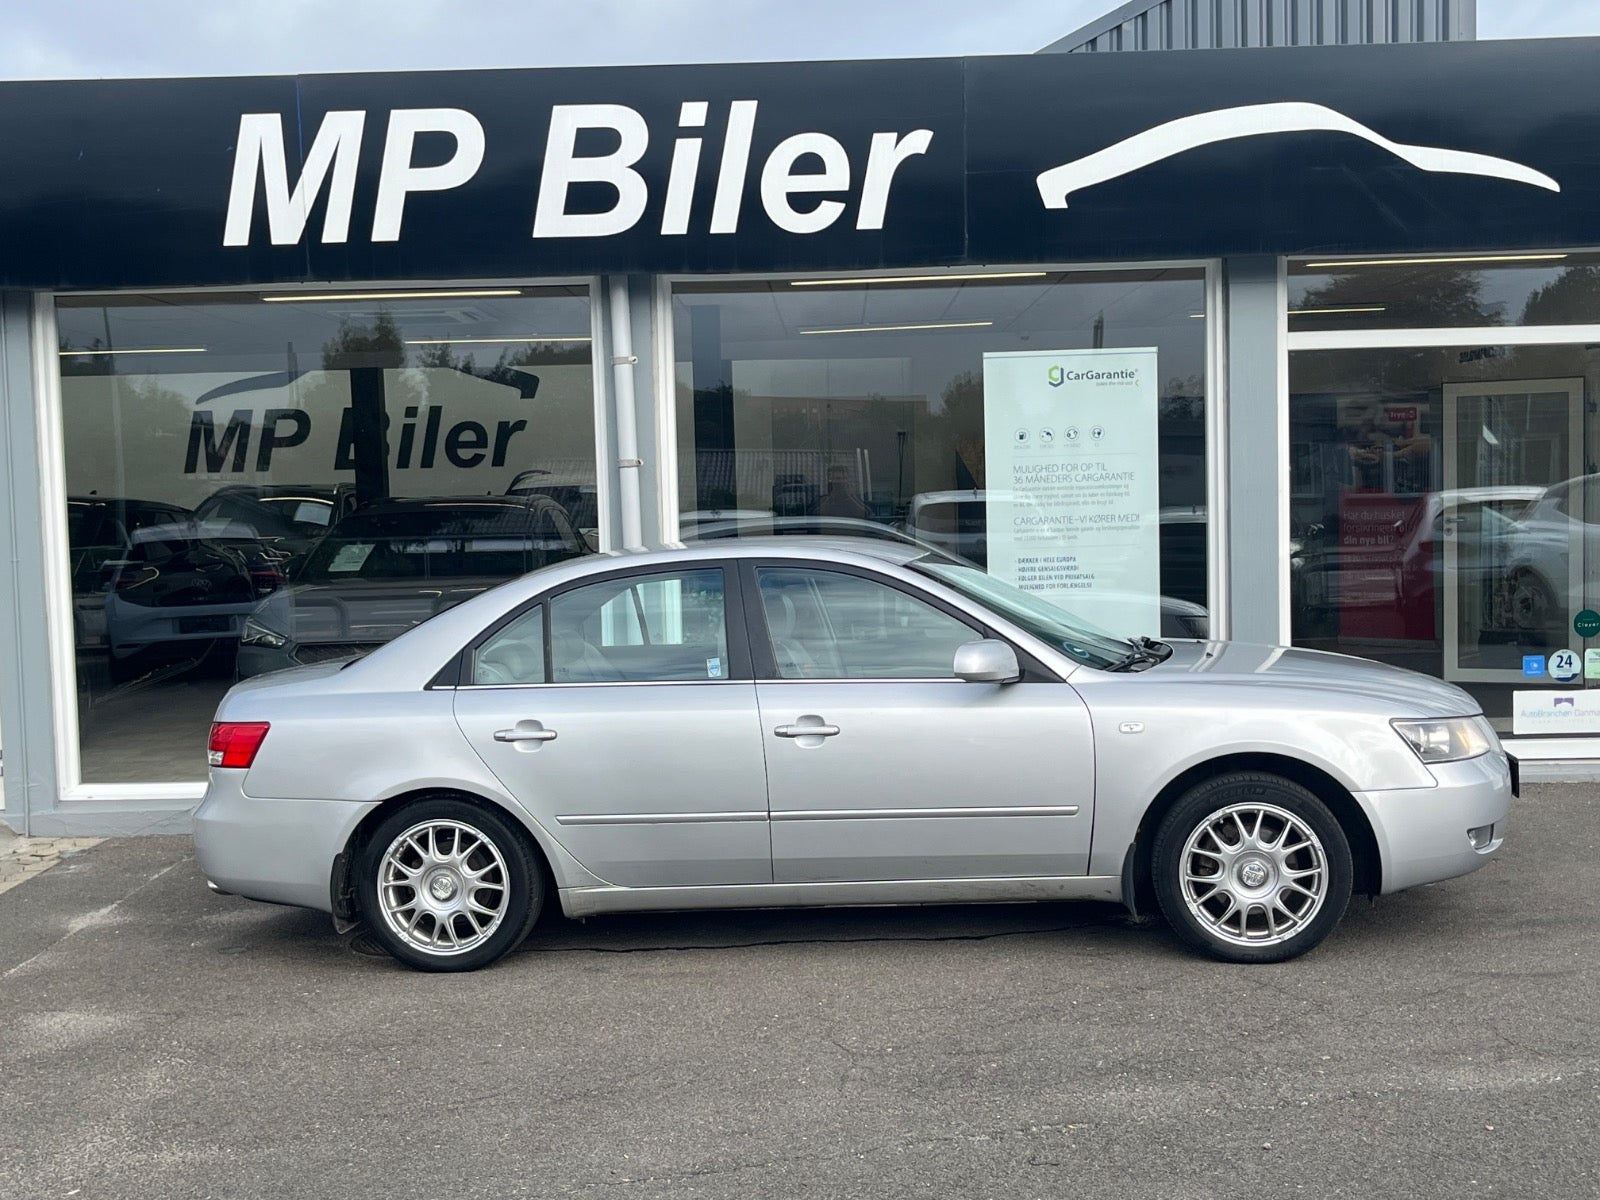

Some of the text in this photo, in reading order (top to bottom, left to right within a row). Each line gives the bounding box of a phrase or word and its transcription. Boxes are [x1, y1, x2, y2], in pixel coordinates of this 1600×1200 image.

[223, 99, 934, 247] MP Biler
[1066, 368, 1135, 381] CarGarantie
[184, 408, 312, 474] MP
[1061, 463, 1079, 473] FOR
[1080, 462, 1094, 472] OP
[1096, 462, 1108, 472] TIL
[1013, 475, 1023, 485] 36
[1074, 471, 1135, 482] CARGARANTIE
[1556, 654, 1573, 668] 24
